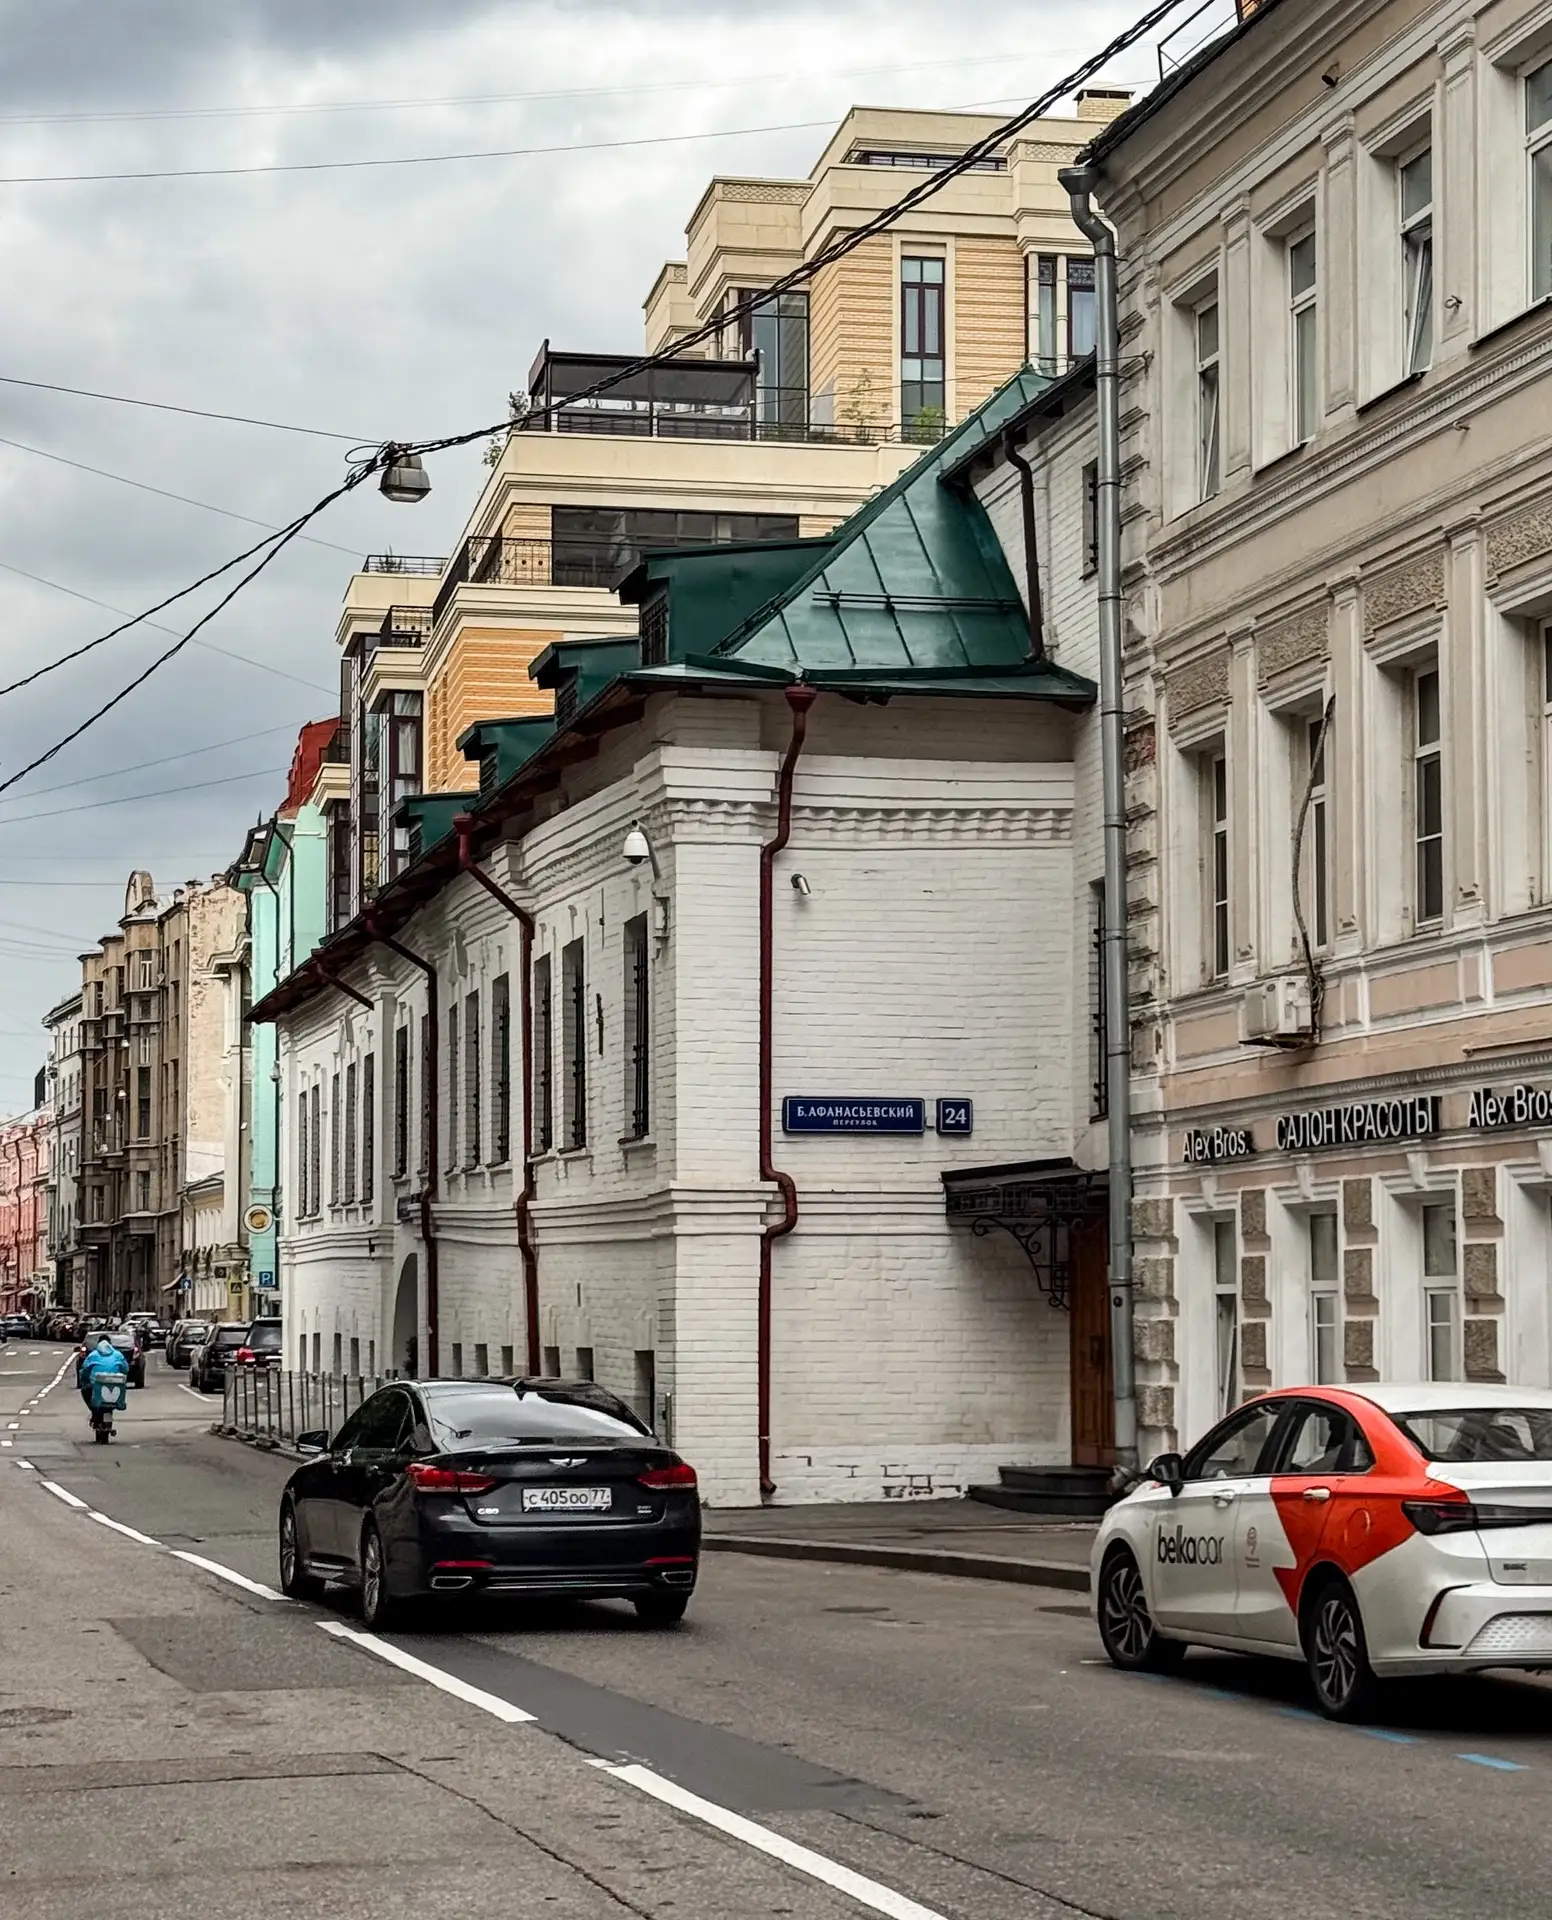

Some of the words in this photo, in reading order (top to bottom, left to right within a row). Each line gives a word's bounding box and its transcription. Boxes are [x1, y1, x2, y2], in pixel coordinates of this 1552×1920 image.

[945, 1107, 967, 1124] 24
[1275, 1109, 1336, 1150] САЛОН
[1341, 1096, 1433, 1143] КРАСОТЫ
[1467, 1088, 1509, 1128] Alex
[1513, 1085, 1552, 1122] Bro
[1181, 1130, 1211, 1162] Alex
[1213, 1127, 1250, 1158] Bros.
[1157, 1524, 1225, 1565] belkacar
